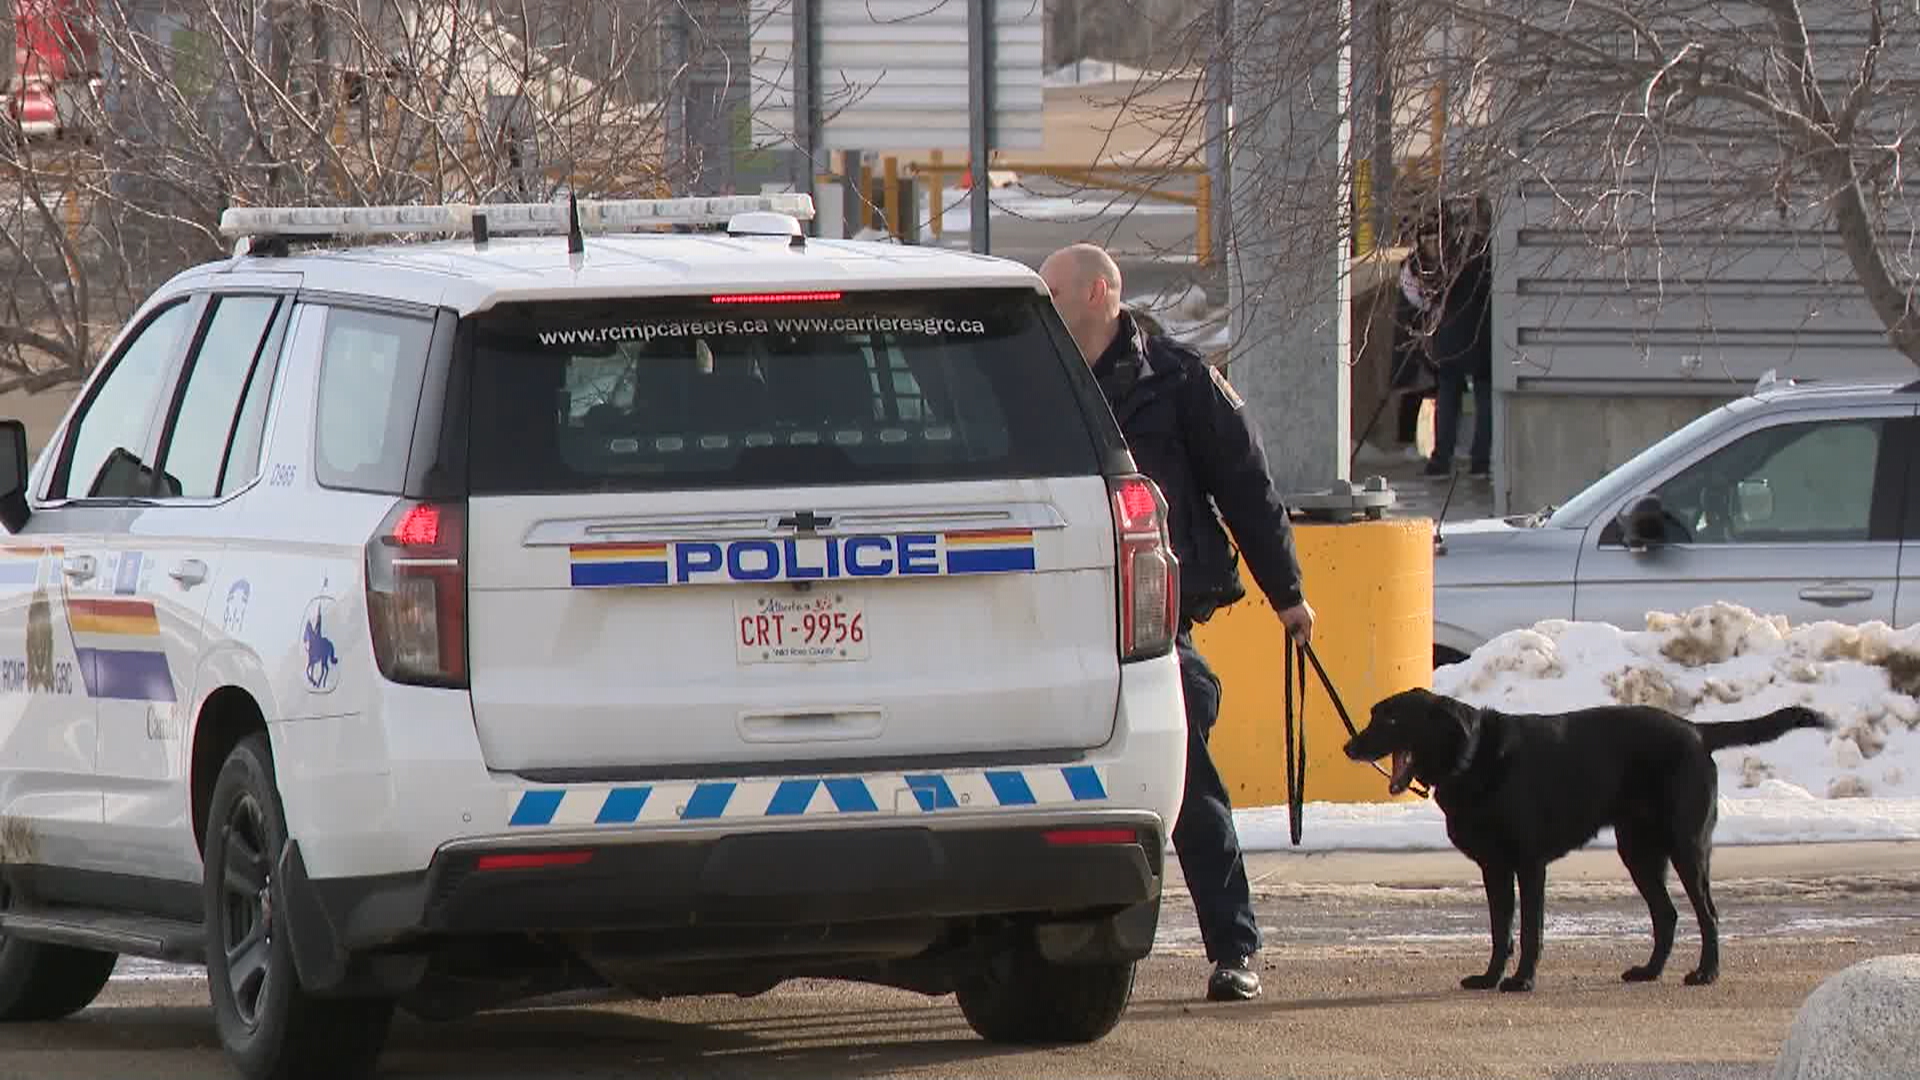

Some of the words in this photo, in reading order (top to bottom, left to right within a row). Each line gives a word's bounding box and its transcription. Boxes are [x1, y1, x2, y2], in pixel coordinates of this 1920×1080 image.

[538, 318, 769, 345] www.rcmpcareers.ca
[774, 314, 986, 336] www.carrieresgrc.ca
[674, 533, 941, 583] POLICE
[740, 610, 864, 647] CRT-9956
[2, 660, 25, 692] RCMP
[55, 662, 73, 695] GRC
